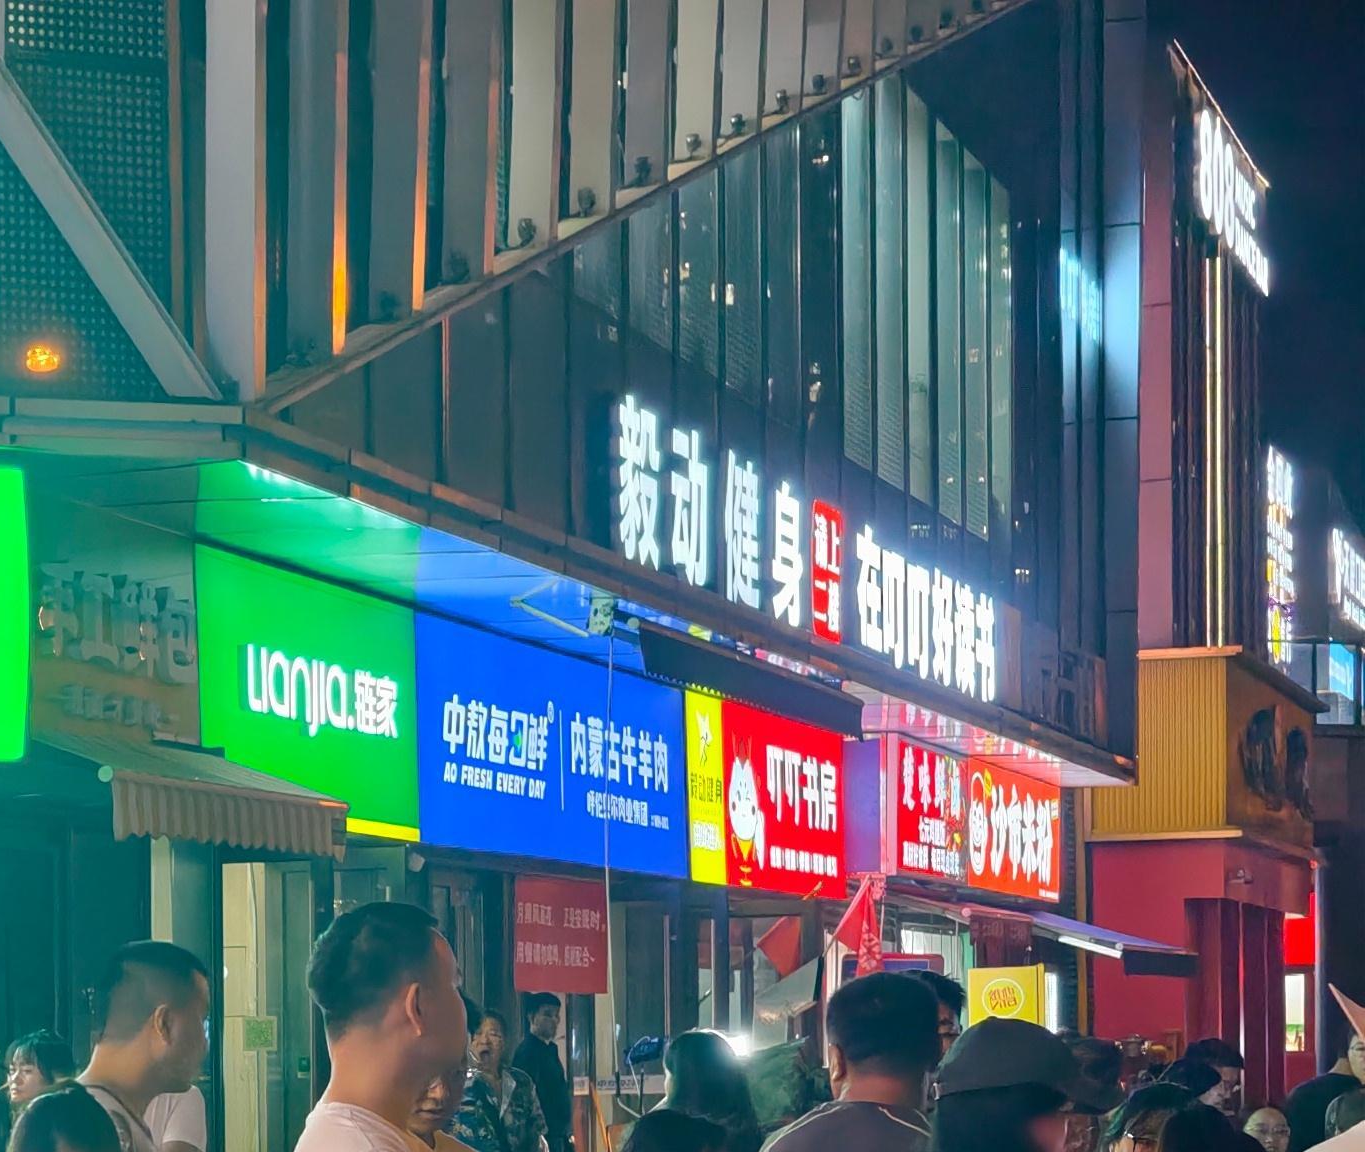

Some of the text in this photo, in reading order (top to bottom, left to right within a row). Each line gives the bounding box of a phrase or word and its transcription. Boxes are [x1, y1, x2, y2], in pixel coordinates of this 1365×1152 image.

[1200, 109, 1235, 249] 808
[618, 395, 804, 628] 毅动健身
[815, 513, 840, 574] 请上
[815, 579, 840, 633] 二楼
[857, 524, 996, 702] 在叮叮好读书
[443, 762, 546, 799] AO FRESH EVERY DAY
[570, 712, 668, 793] 内蒙古牛羊肉
[766, 744, 837, 833] 叮叮书房
